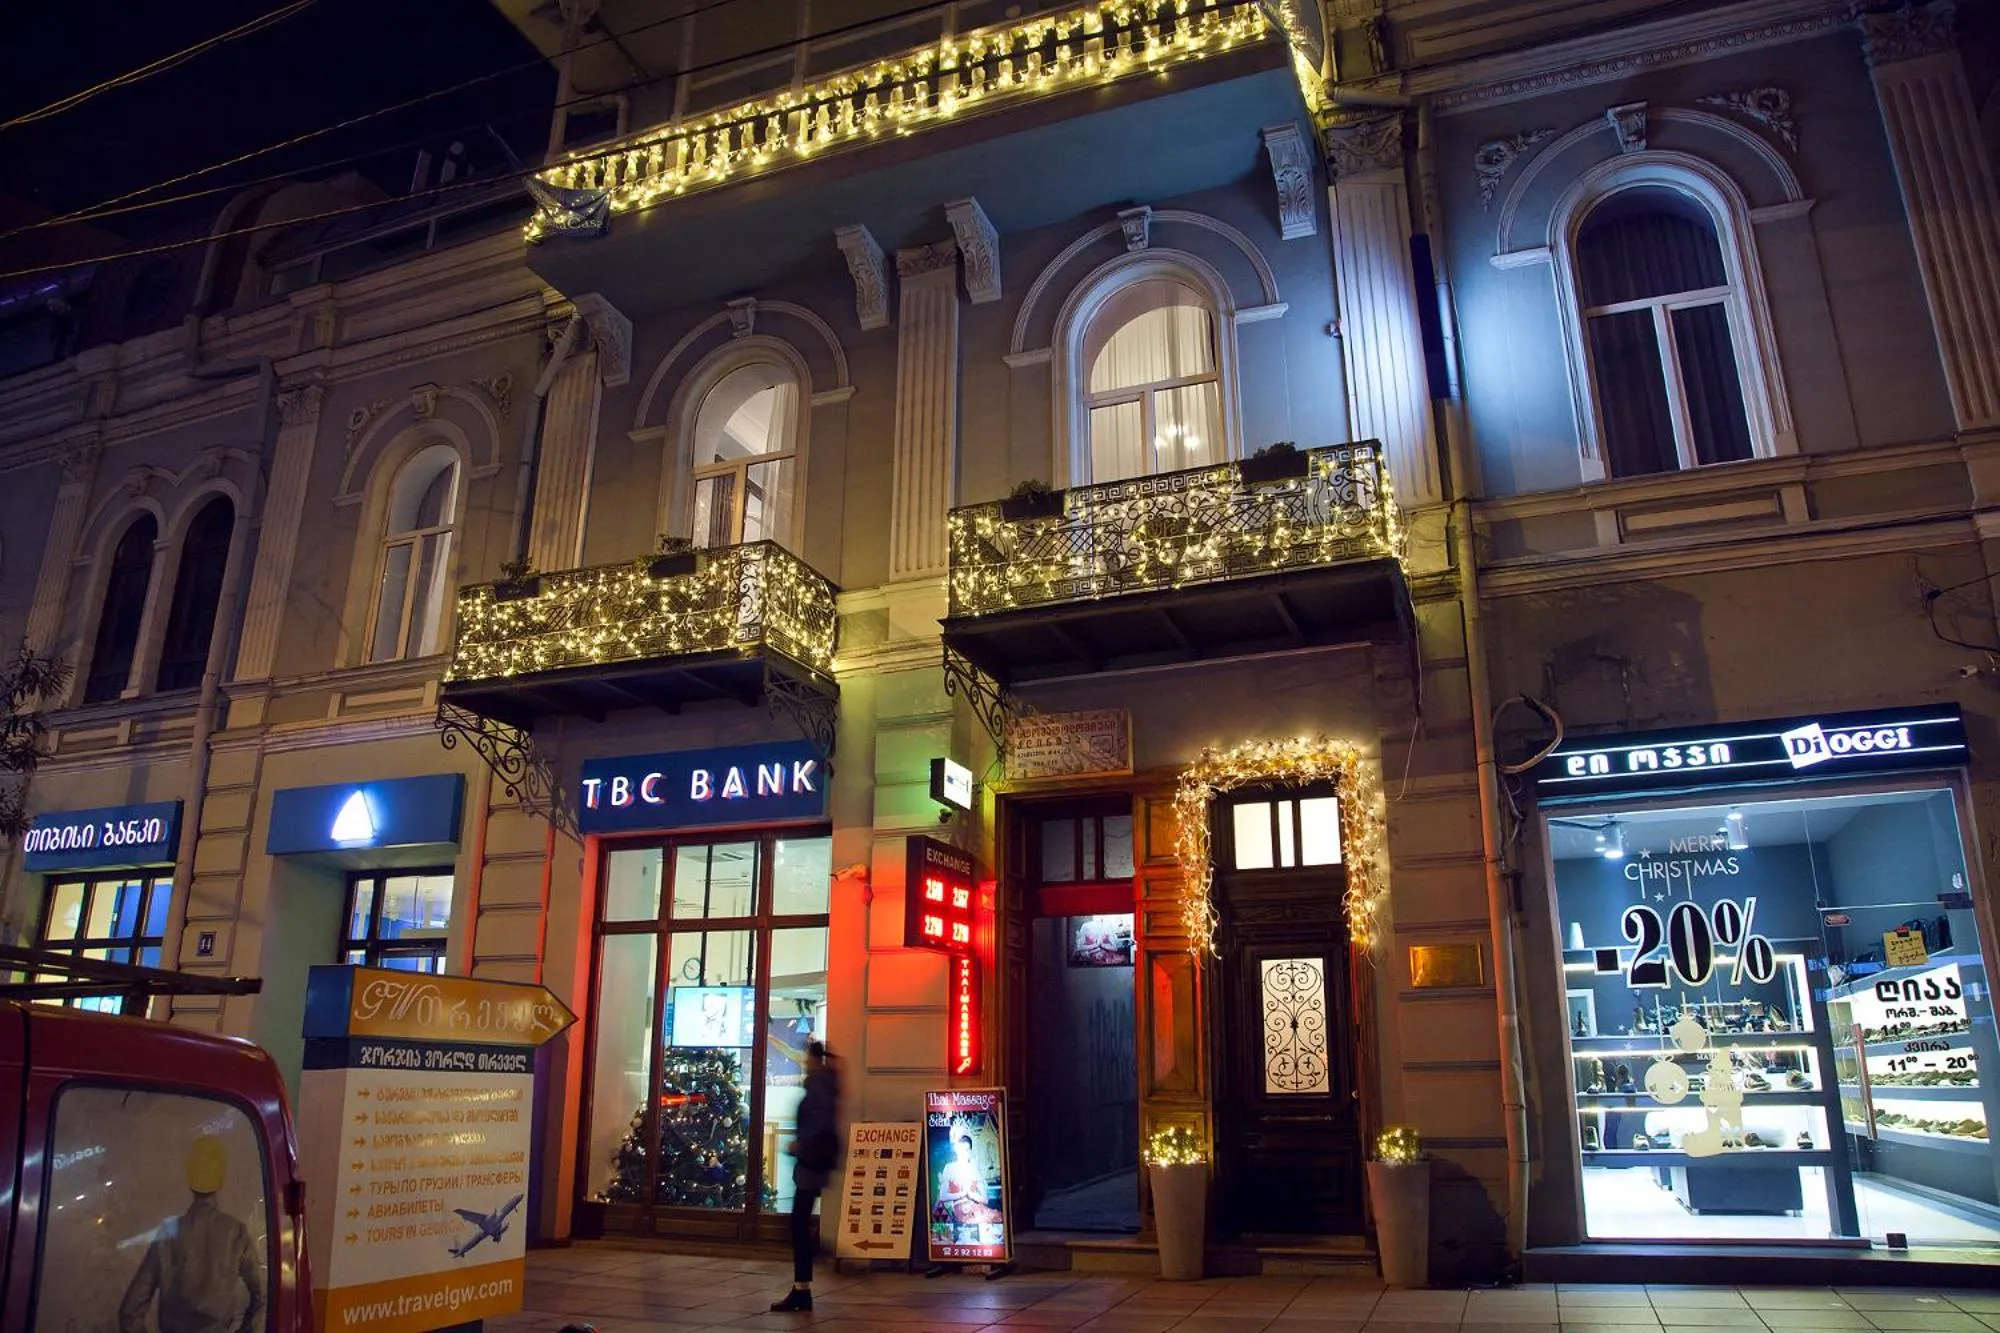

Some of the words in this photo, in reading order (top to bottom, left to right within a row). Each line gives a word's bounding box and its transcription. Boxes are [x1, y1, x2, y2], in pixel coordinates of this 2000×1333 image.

[1567, 754, 1609, 776] დი
[1628, 743, 1730, 771] ოჯჯი
[582, 771, 665, 809] TBC
[690, 759, 817, 801] BANK
[24, 824, 94, 852] თიბისი
[103, 818, 160, 846] ბანკი
[1669, 835, 1730, 854] MERRY
[926, 847, 971, 875] EXCHANGE
[1624, 857, 1740, 896] CHRISTMAS
[1595, 897, 1776, 989] -20%
[961, 959, 970, 994] THAI
[1875, 977, 1962, 1002] ღიაა
[960, 994, 970, 1057] MASSAGE
[1904, 1041, 1950, 1053] კვირა
[928, 1092, 949, 1106] Thai
[951, 1092, 996, 1110] Massage
[856, 1129, 917, 1142] EXCHANGE
[369, 1181, 399, 1195] ТУРЫ
[401, 1180, 416, 1193] ПО
[420, 1176, 458, 1191] ГРУЗИИ
[466, 1171, 524, 1186] ТРАНСФЕРЫ
[368, 1199, 444, 1218] АВИАБИЛЕТЫ
[368, 1224, 401, 1243] TOURS
[406, 1223, 417, 1240] IN
[343, 1279, 513, 1326] www.travelgw.com
